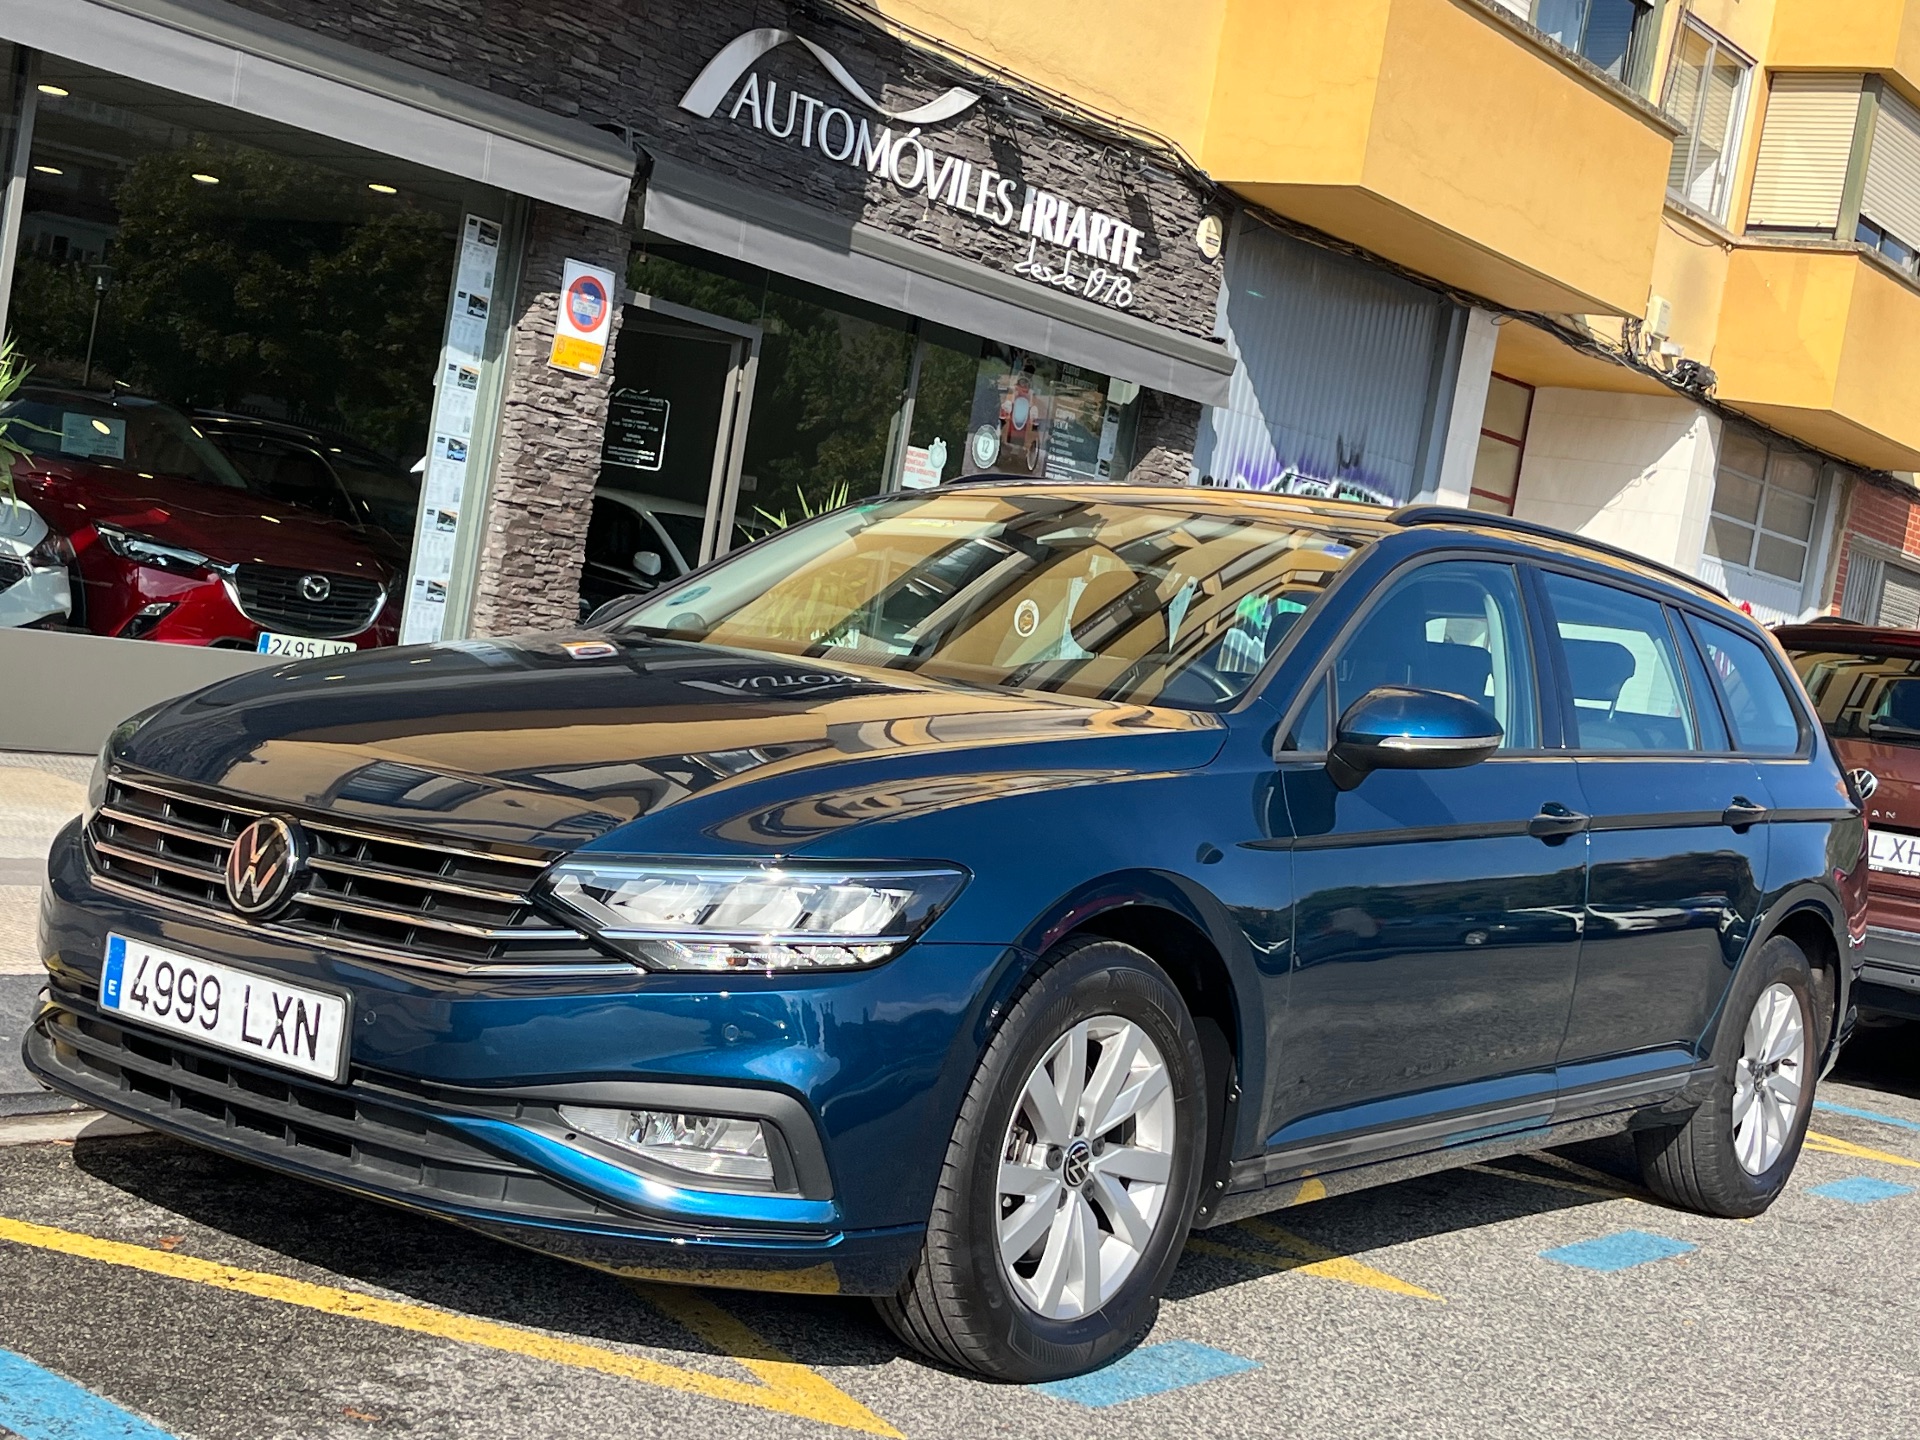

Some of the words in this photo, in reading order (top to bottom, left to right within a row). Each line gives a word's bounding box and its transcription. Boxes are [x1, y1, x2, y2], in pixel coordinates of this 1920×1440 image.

[729, 72, 1018, 226] AUTOMÓVILES
[1019, 186, 1146, 274] IRIARTE
[1013, 238, 1077, 291] desde
[1083, 268, 1133, 308] 1978
[107, 979, 118, 996] E
[130, 955, 221, 1031] 4999
[241, 985, 322, 1061] LXN
